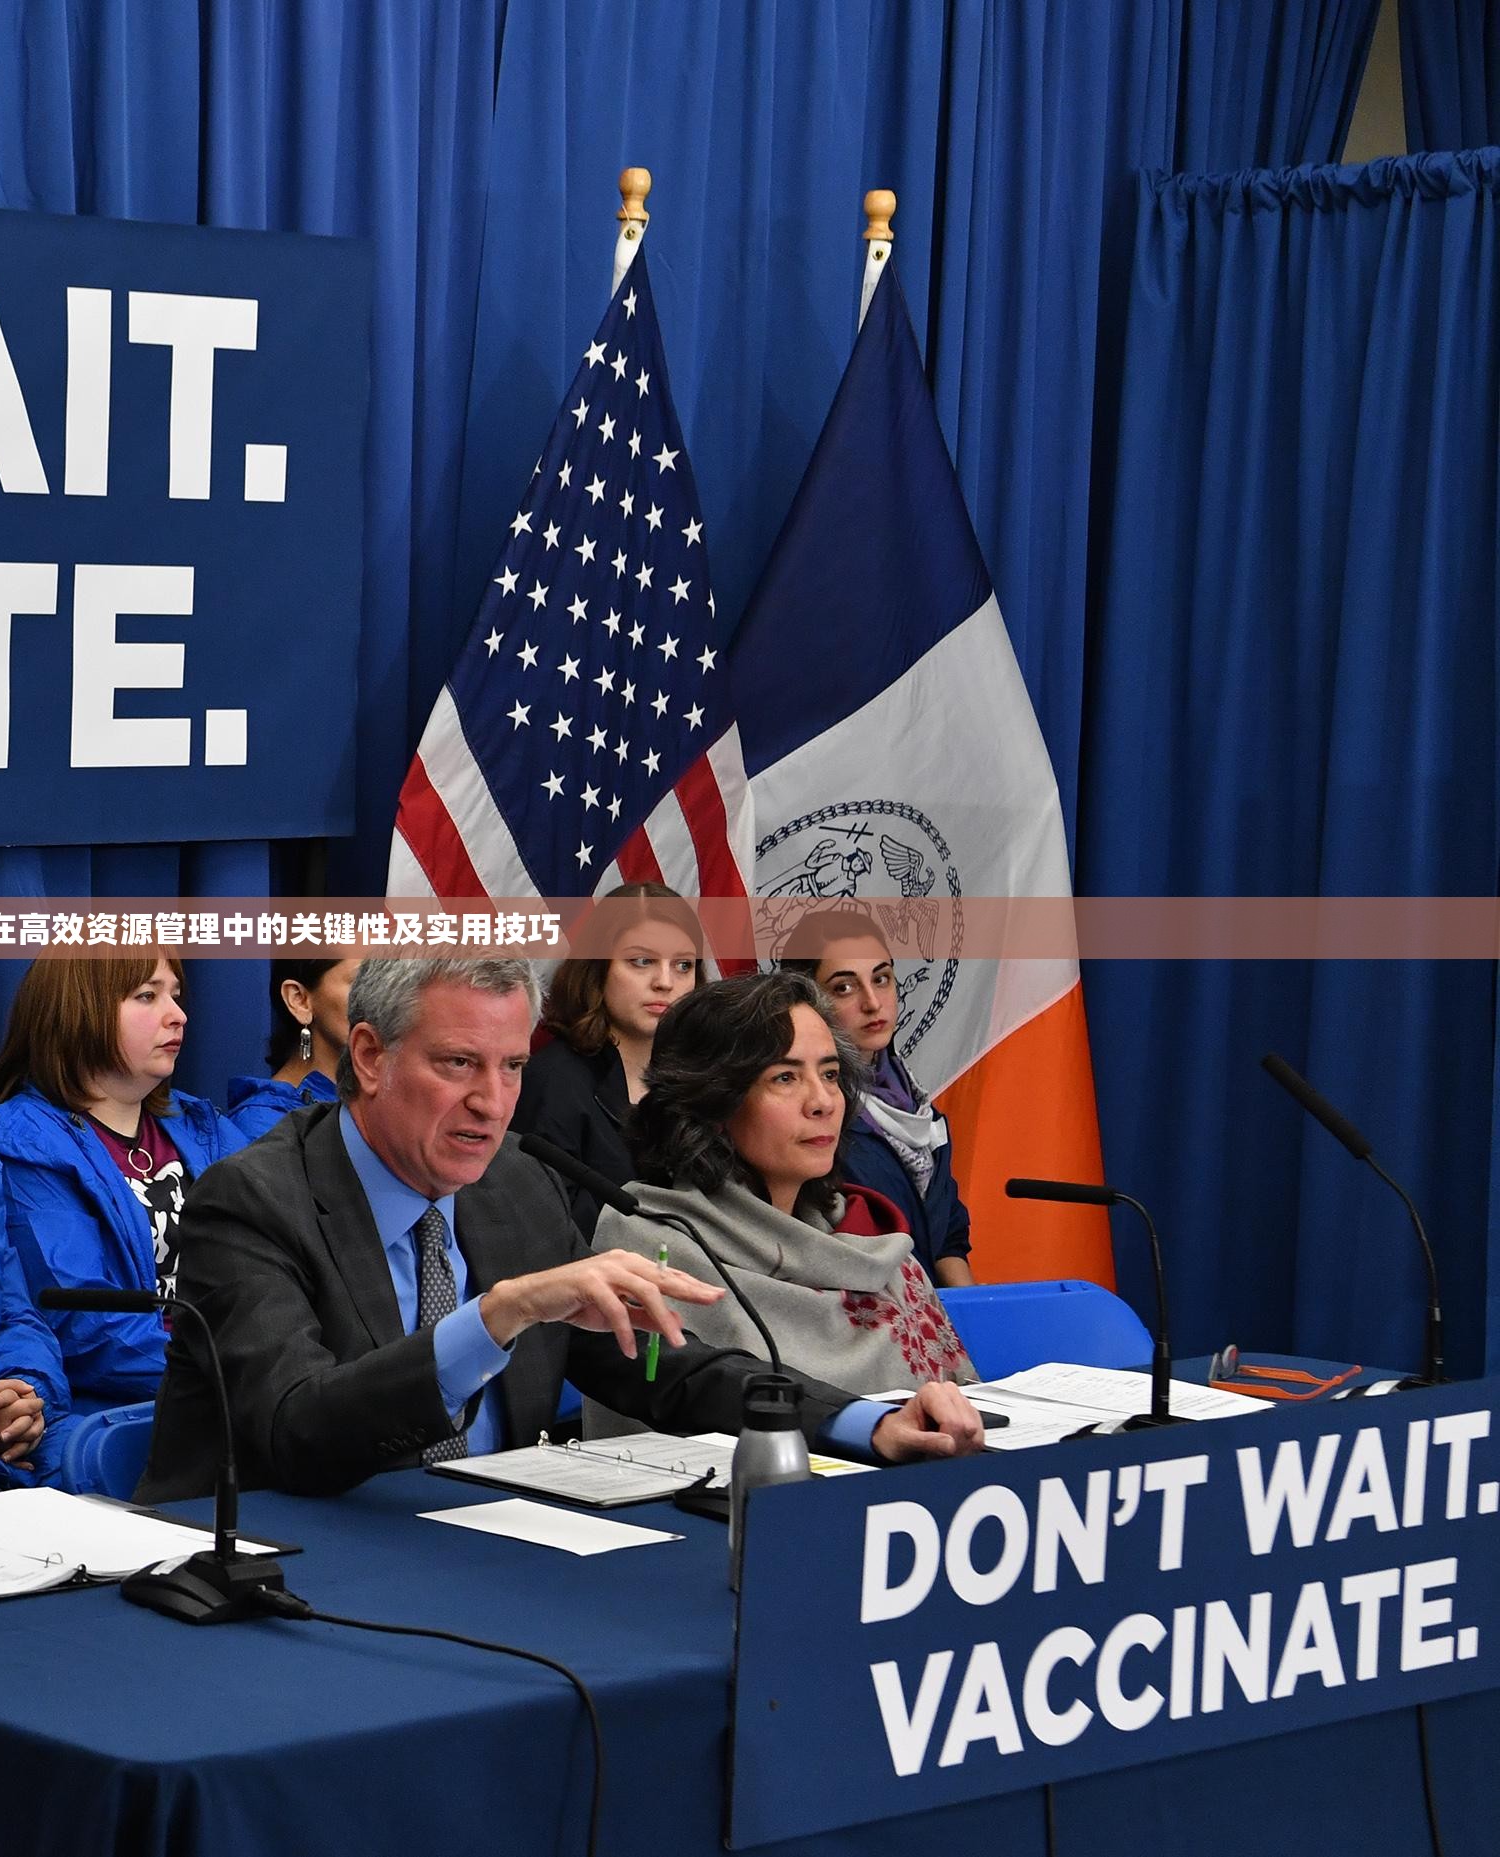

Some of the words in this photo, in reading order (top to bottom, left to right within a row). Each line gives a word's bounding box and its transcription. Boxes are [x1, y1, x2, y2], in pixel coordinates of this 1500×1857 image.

[860, 1454, 1210, 1624] DON’T
[1236, 1409, 1500, 1556] WAIT.
[870, 1557, 1479, 1777] VACCINATE.
